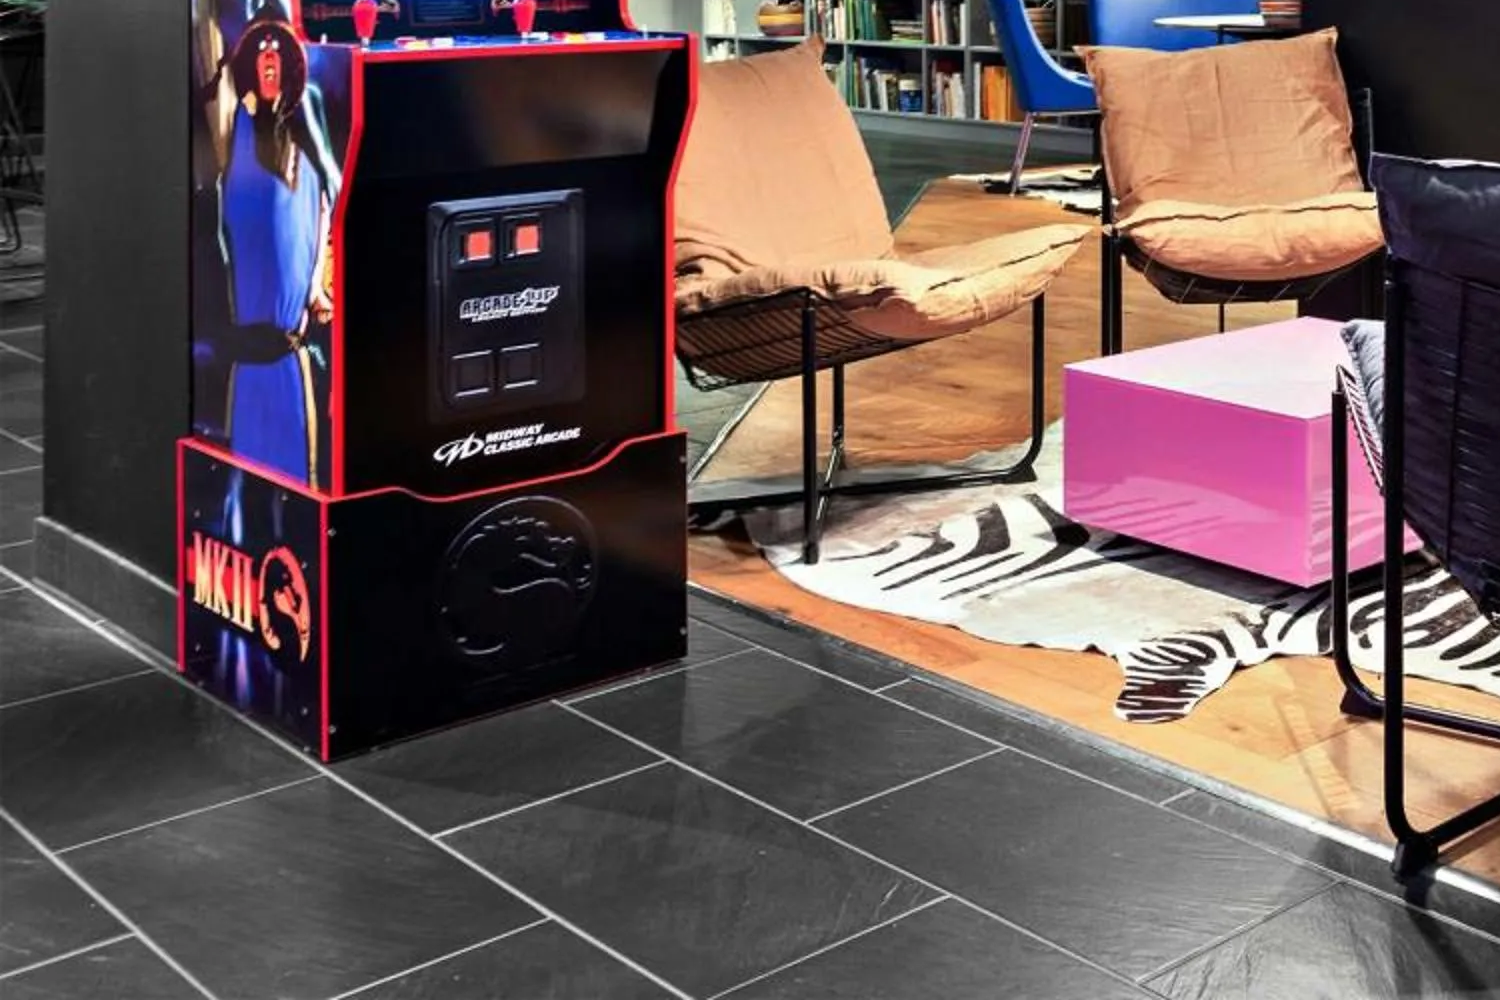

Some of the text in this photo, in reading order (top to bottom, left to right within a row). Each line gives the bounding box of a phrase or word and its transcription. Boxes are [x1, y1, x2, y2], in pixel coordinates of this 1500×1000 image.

[483, 427, 582, 456] CLASSIC ARCADE
[485, 422, 545, 444] MIDWAY
[194, 530, 256, 633] MKII
